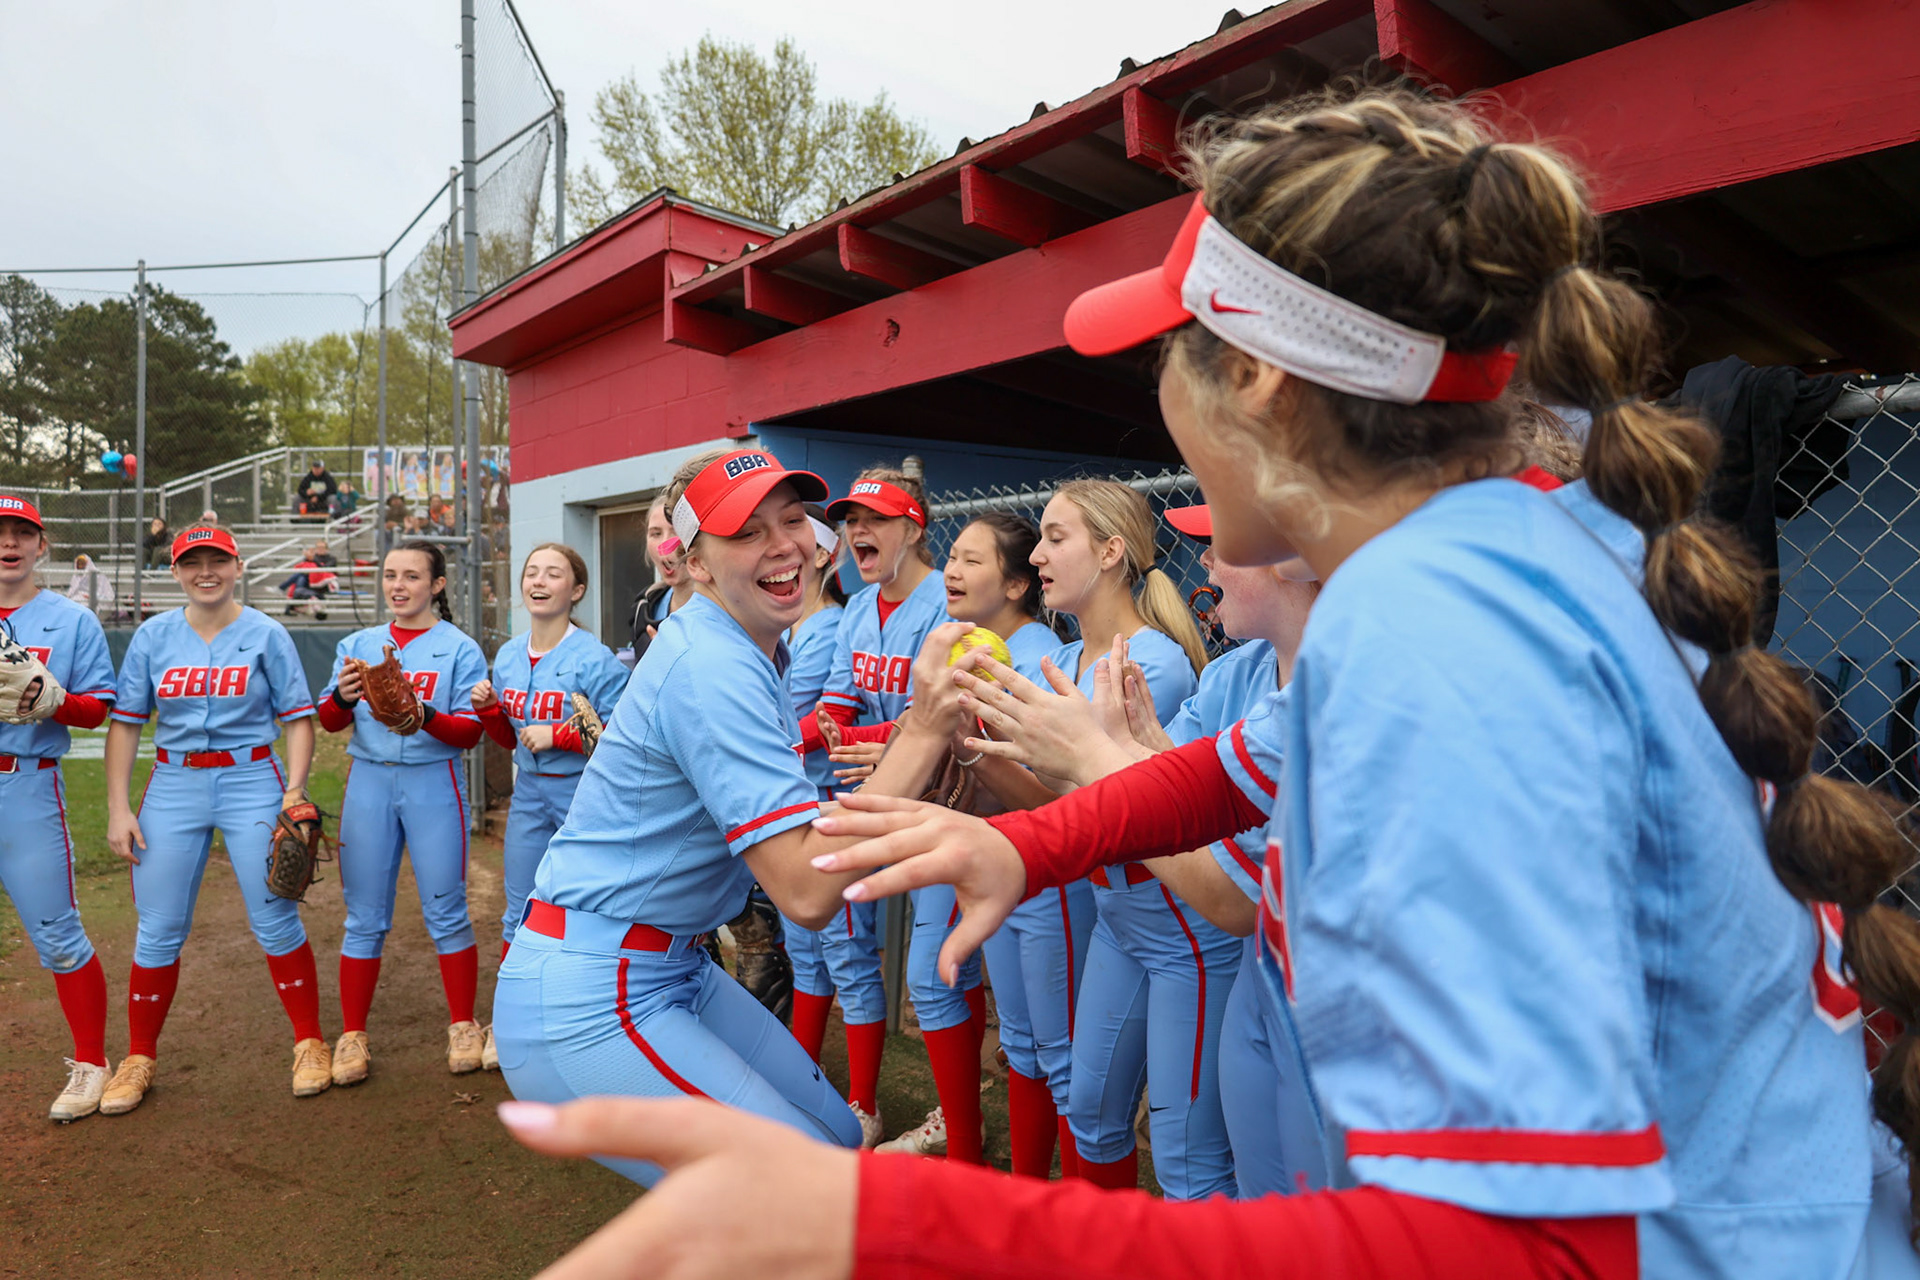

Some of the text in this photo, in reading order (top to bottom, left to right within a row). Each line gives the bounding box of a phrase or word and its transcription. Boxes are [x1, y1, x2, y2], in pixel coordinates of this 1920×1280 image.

[724, 454, 771, 480] SBA
[0, 498, 24, 510] BA
[852, 482, 882, 496] SBA
[157, 664, 250, 699] SBA
[851, 650, 912, 694] SBA
[502, 687, 566, 721] SBA
